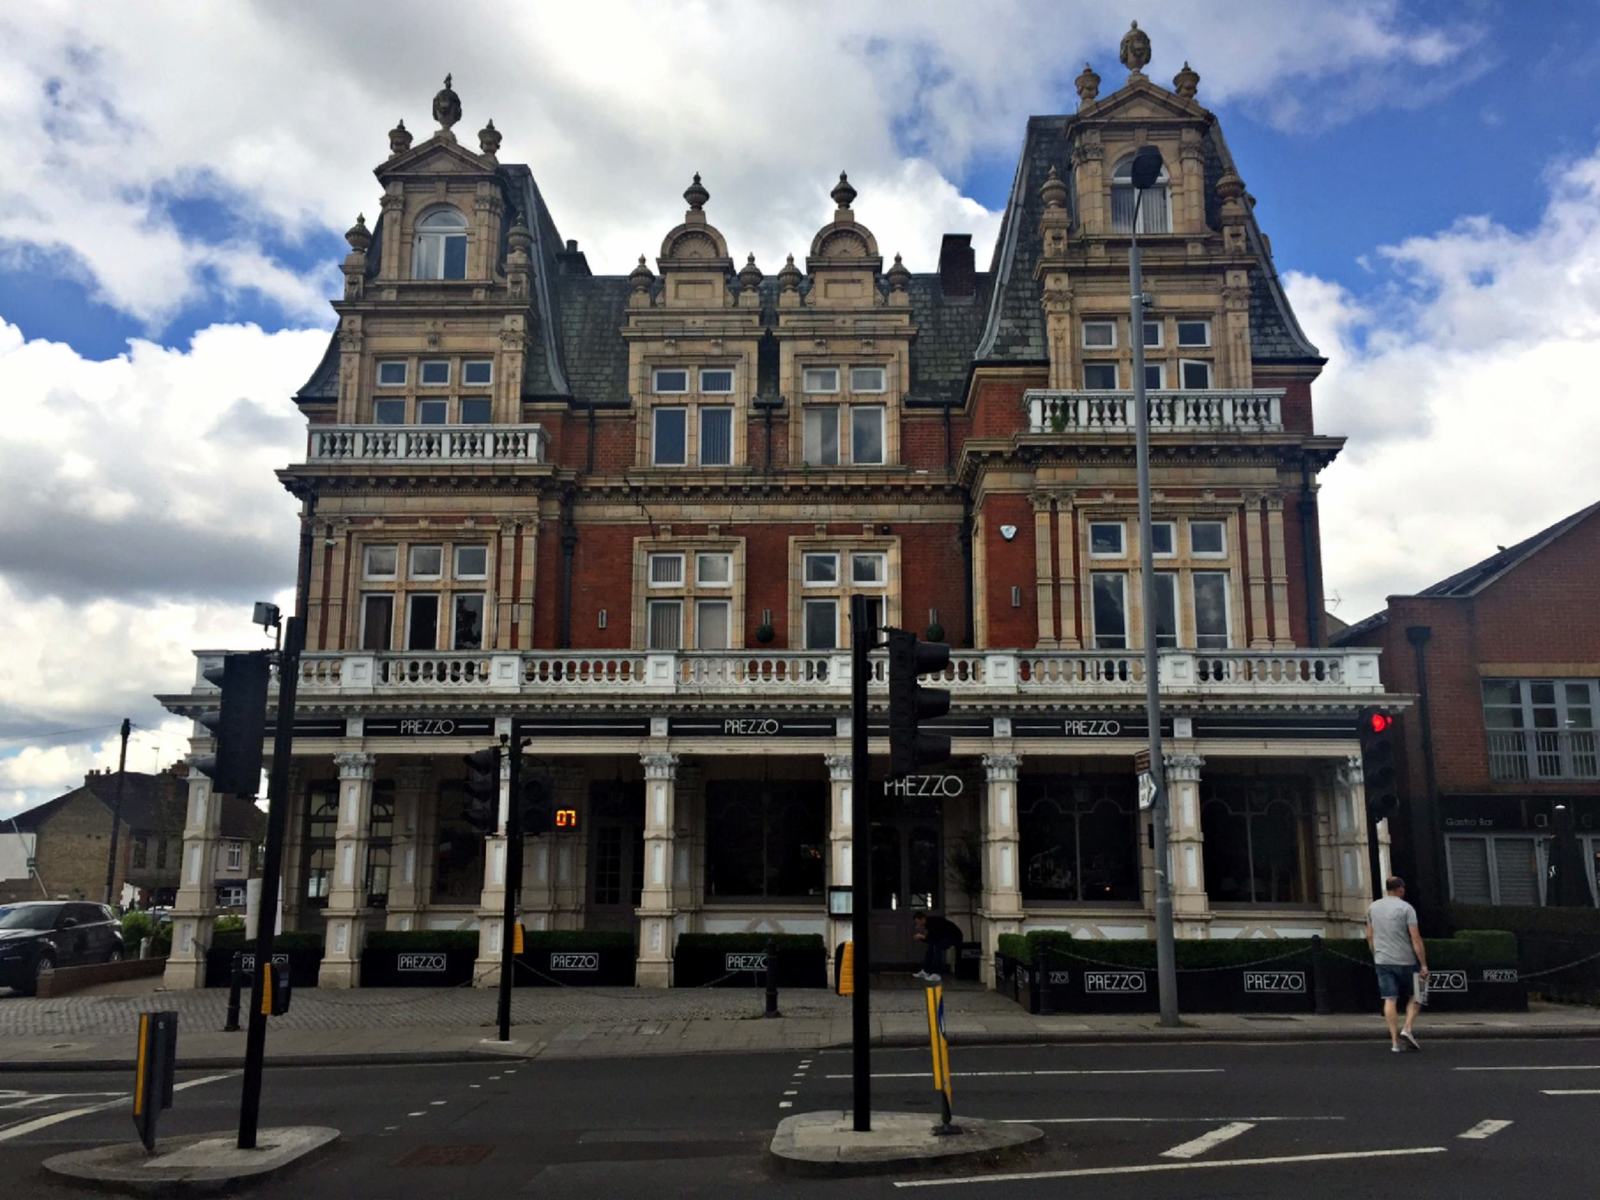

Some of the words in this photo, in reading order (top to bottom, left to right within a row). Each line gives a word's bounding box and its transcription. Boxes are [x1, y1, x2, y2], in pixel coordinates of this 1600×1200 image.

[400, 719, 454, 734] PREZZO
[724, 718, 779, 735] PREZZO
[1064, 719, 1120, 736] PREZZO
[555, 808, 577, 827] 07
[400, 955, 444, 969] PREZZO
[552, 955, 596, 968] PREZZO
[1087, 974, 1143, 991] PREZZO
[1247, 973, 1303, 990] PREZZO
